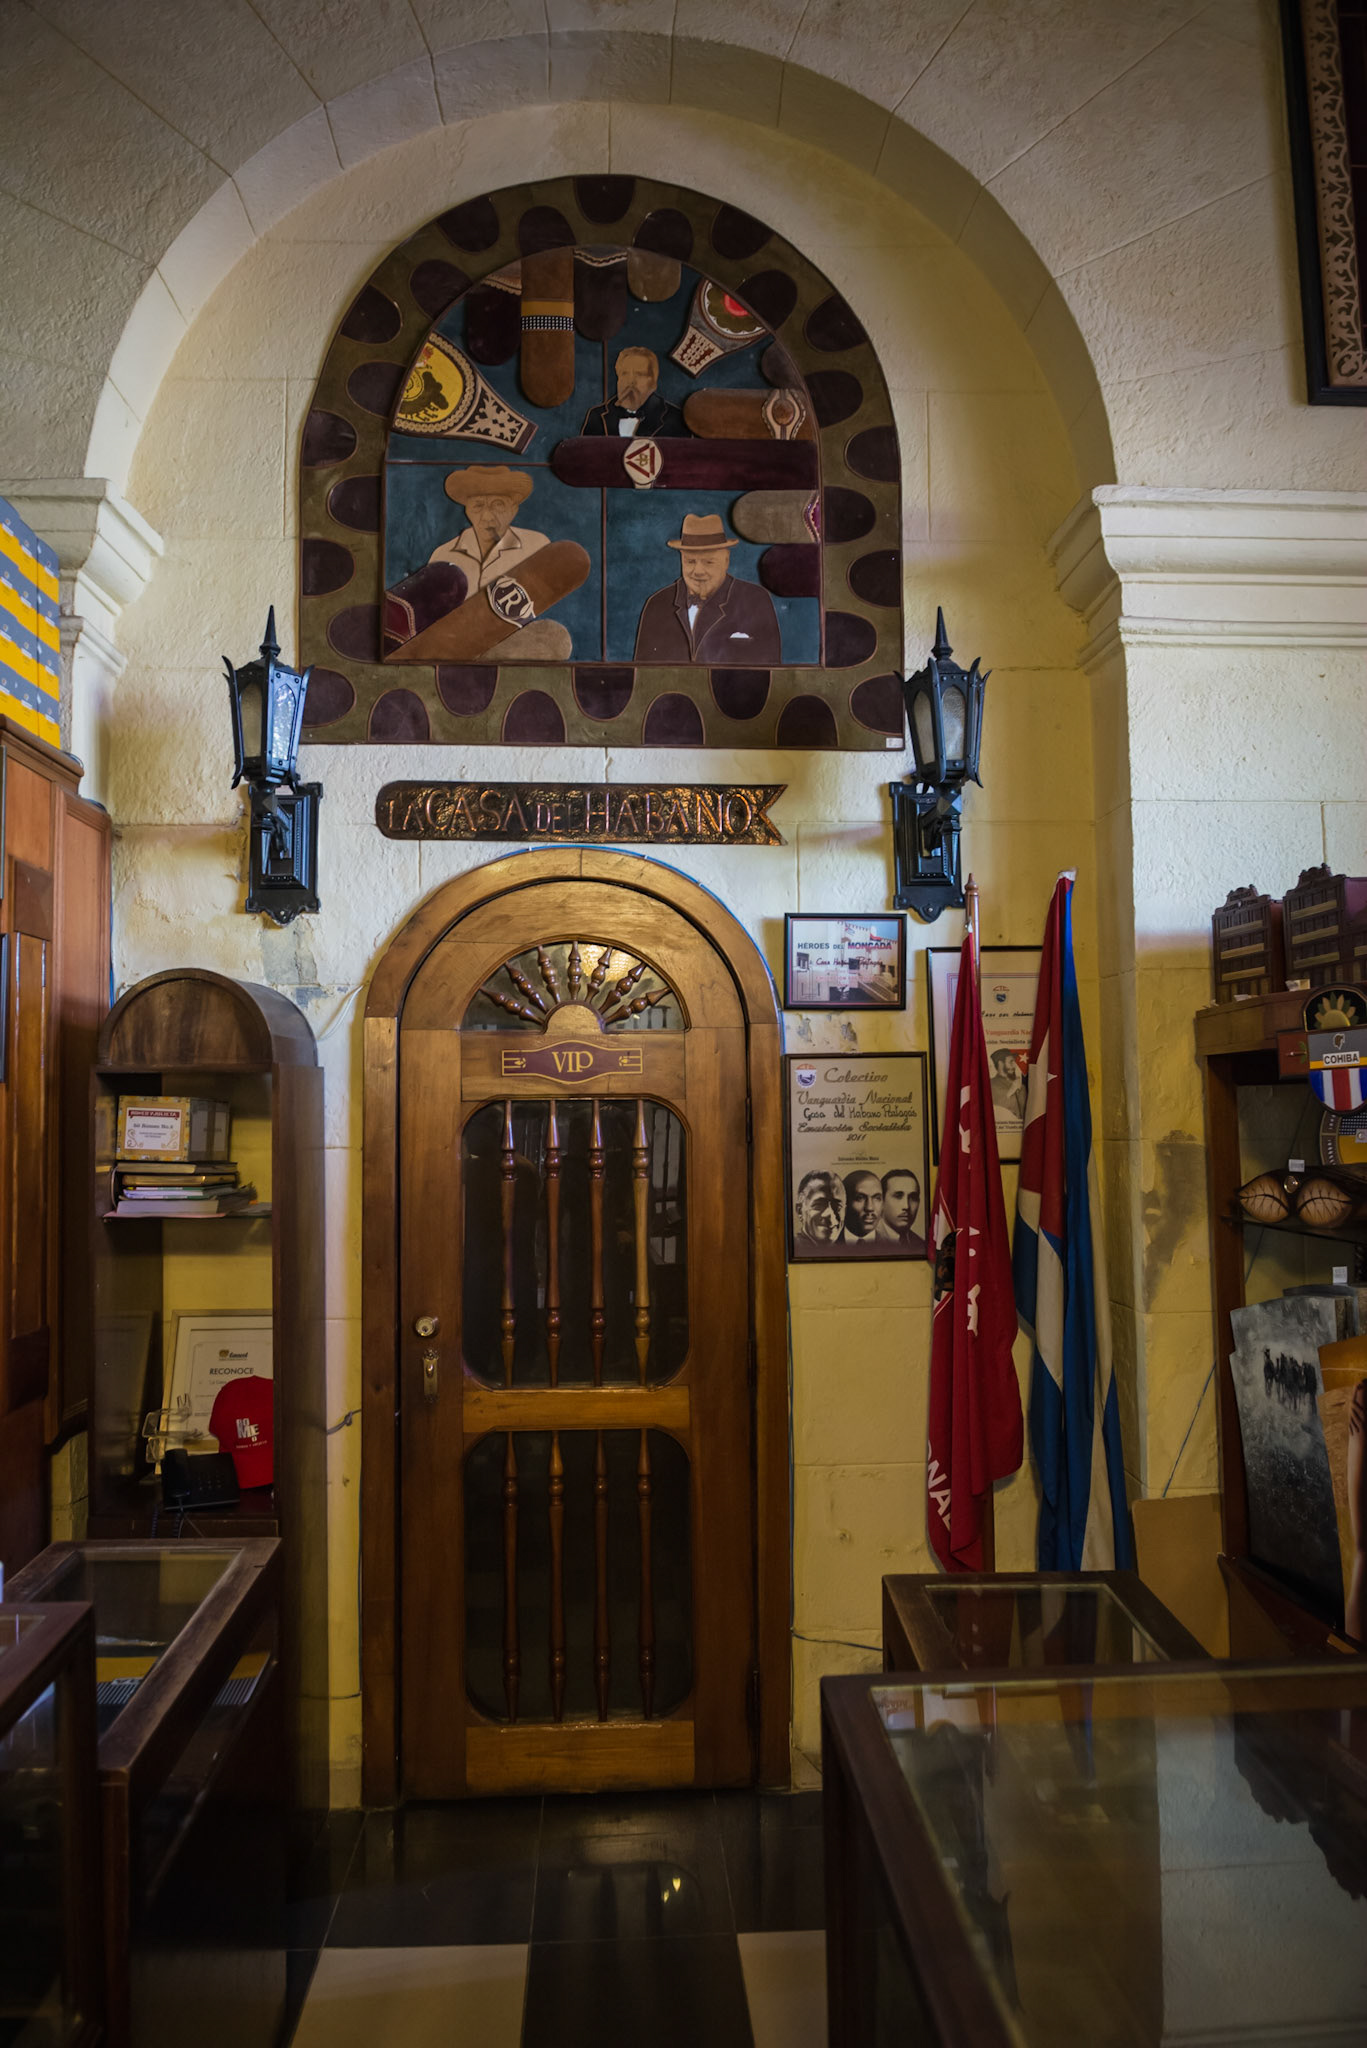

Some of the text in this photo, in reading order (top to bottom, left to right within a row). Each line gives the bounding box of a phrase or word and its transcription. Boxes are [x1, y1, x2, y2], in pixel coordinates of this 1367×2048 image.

[388, 788, 753, 835] LA CASA DEL HABANO
[797, 942, 830, 950] HEROES
[847, 941, 892, 951] MONCADA
[551, 1050, 594, 1073] VIP
[1323, 1053, 1359, 1066] COHIBA
[796, 1089, 913, 1108] Vanguardia Nacional
[803, 1107, 826, 1121] Casa
[834, 1104, 845, 1118] del
[849, 1105, 882, 1119] Habano
[845, 1133, 867, 1142] 2011
[209, 1367, 255, 1375] RECONOCE
